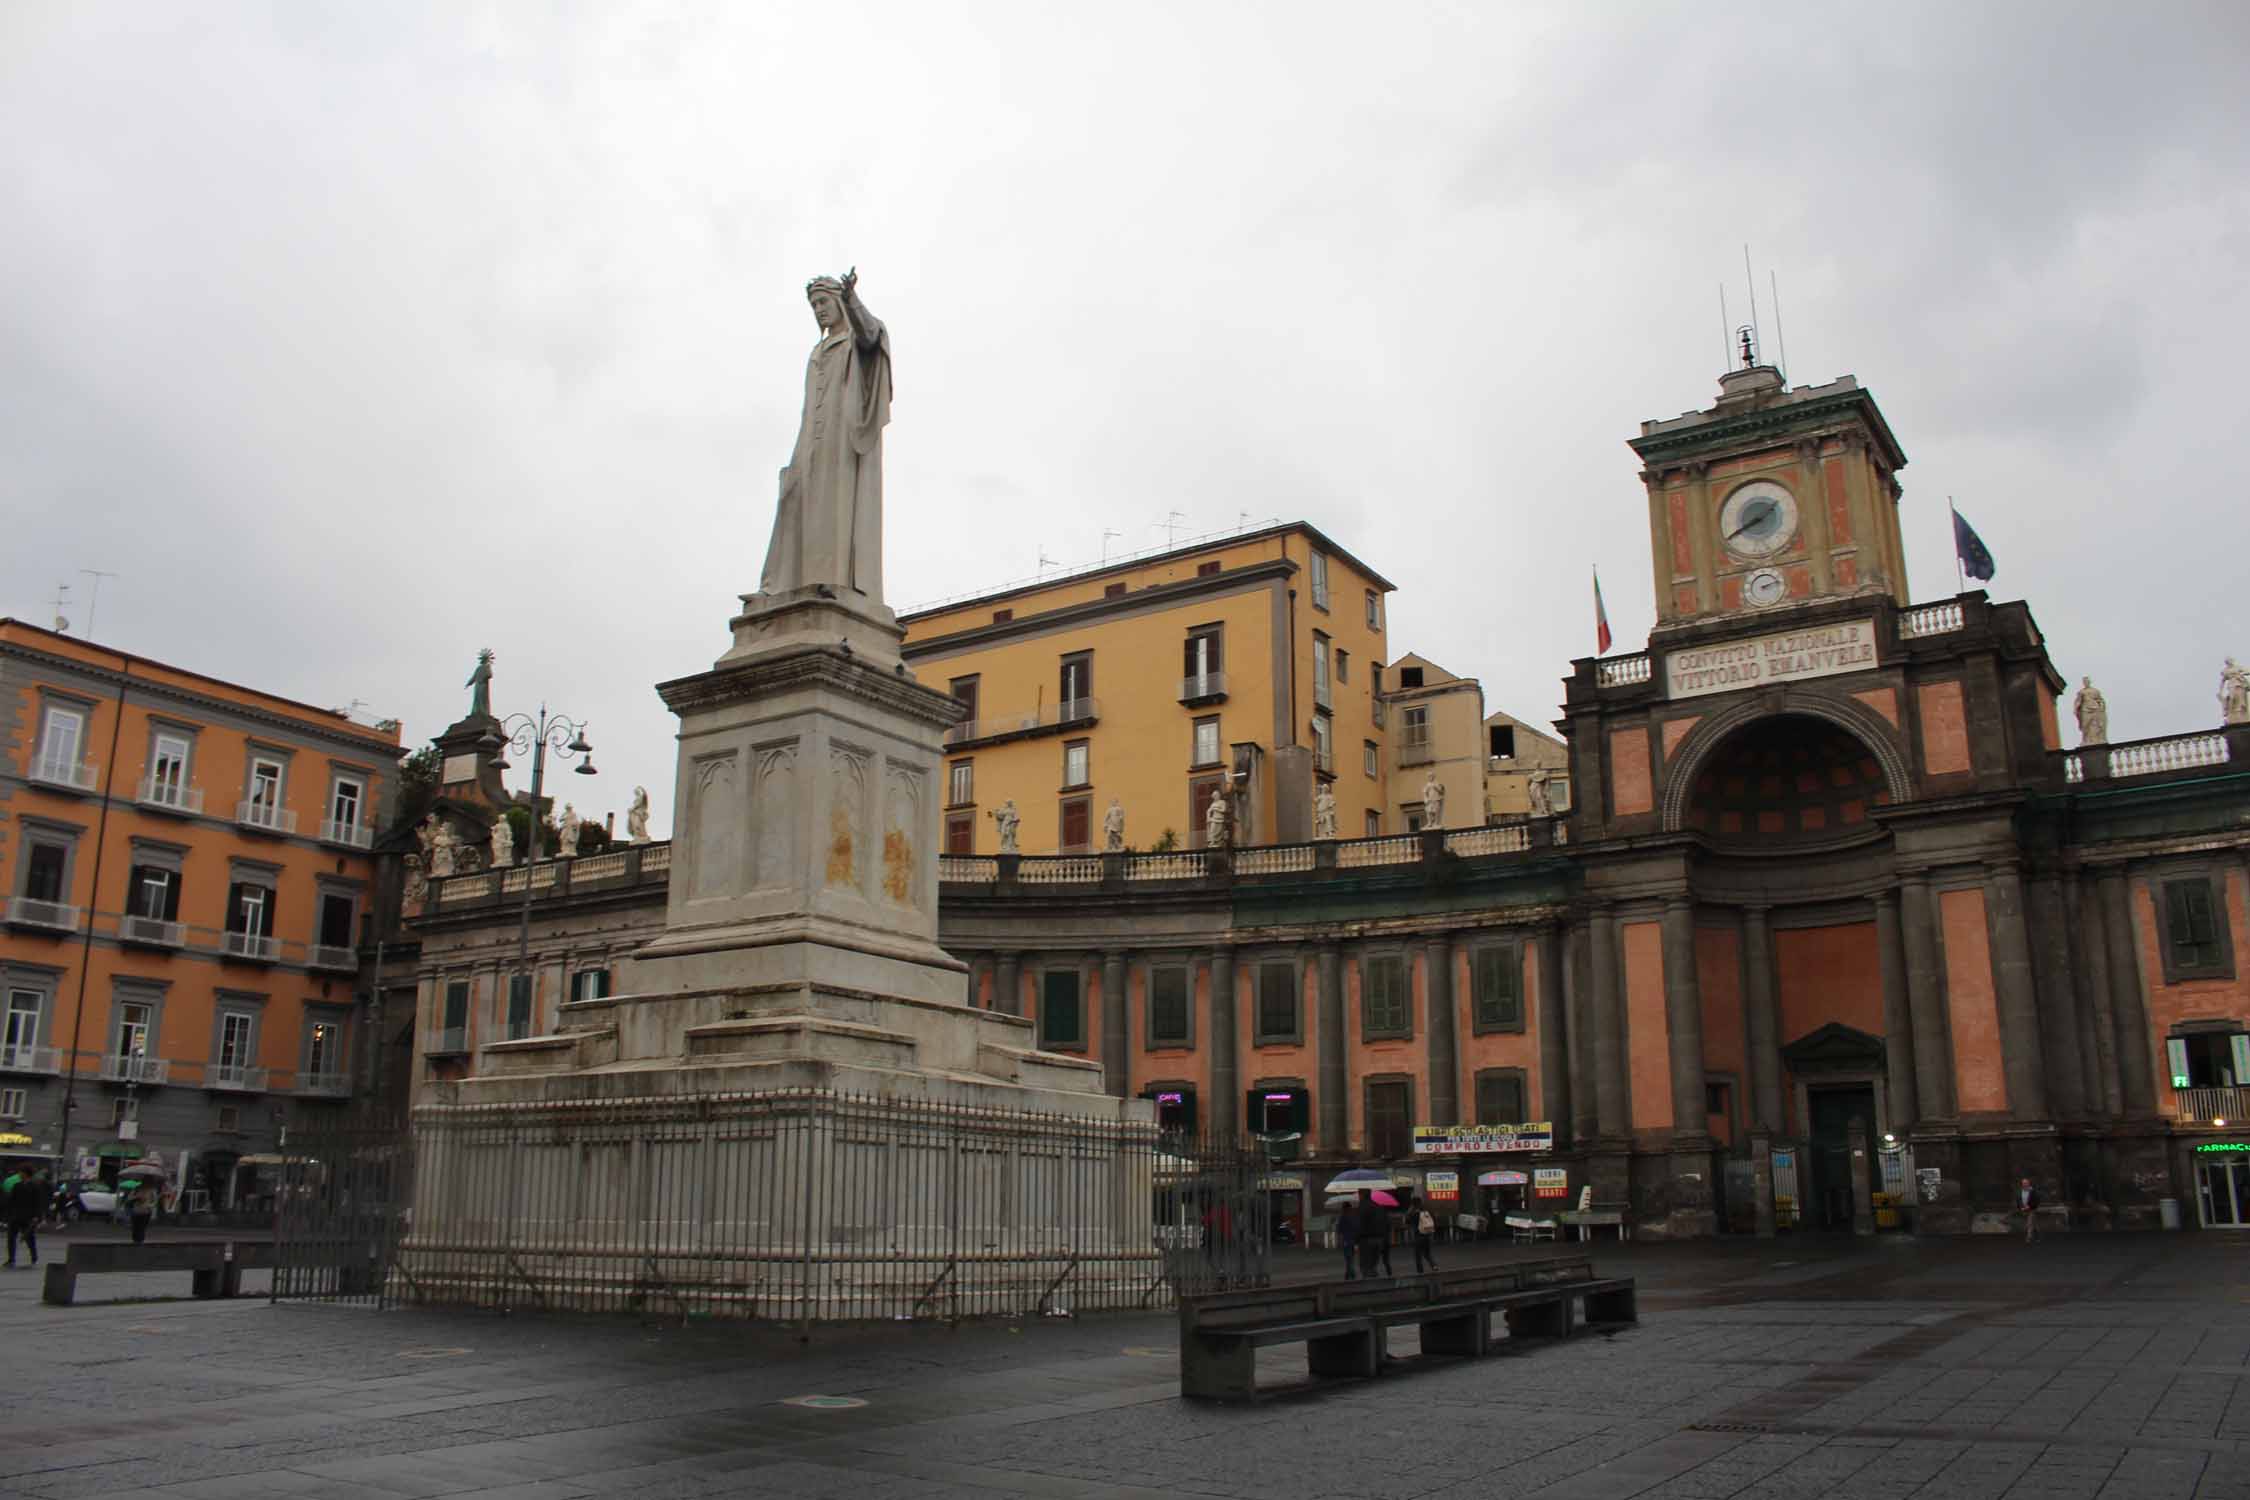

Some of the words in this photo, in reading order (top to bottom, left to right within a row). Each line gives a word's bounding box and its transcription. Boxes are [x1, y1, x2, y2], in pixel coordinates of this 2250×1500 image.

[1679, 643, 1757, 670] CONVITTO
[1764, 627, 1860, 658] NAZIONALE
[1671, 662, 1760, 691] VITTORIO
[1425, 1127, 1450, 1136] LIBRI
[1425, 1142, 1480, 1151] COMPRO
[1497, 1140, 1541, 1150] VENDO
[2196, 1143, 2250, 1153] FARMACI
